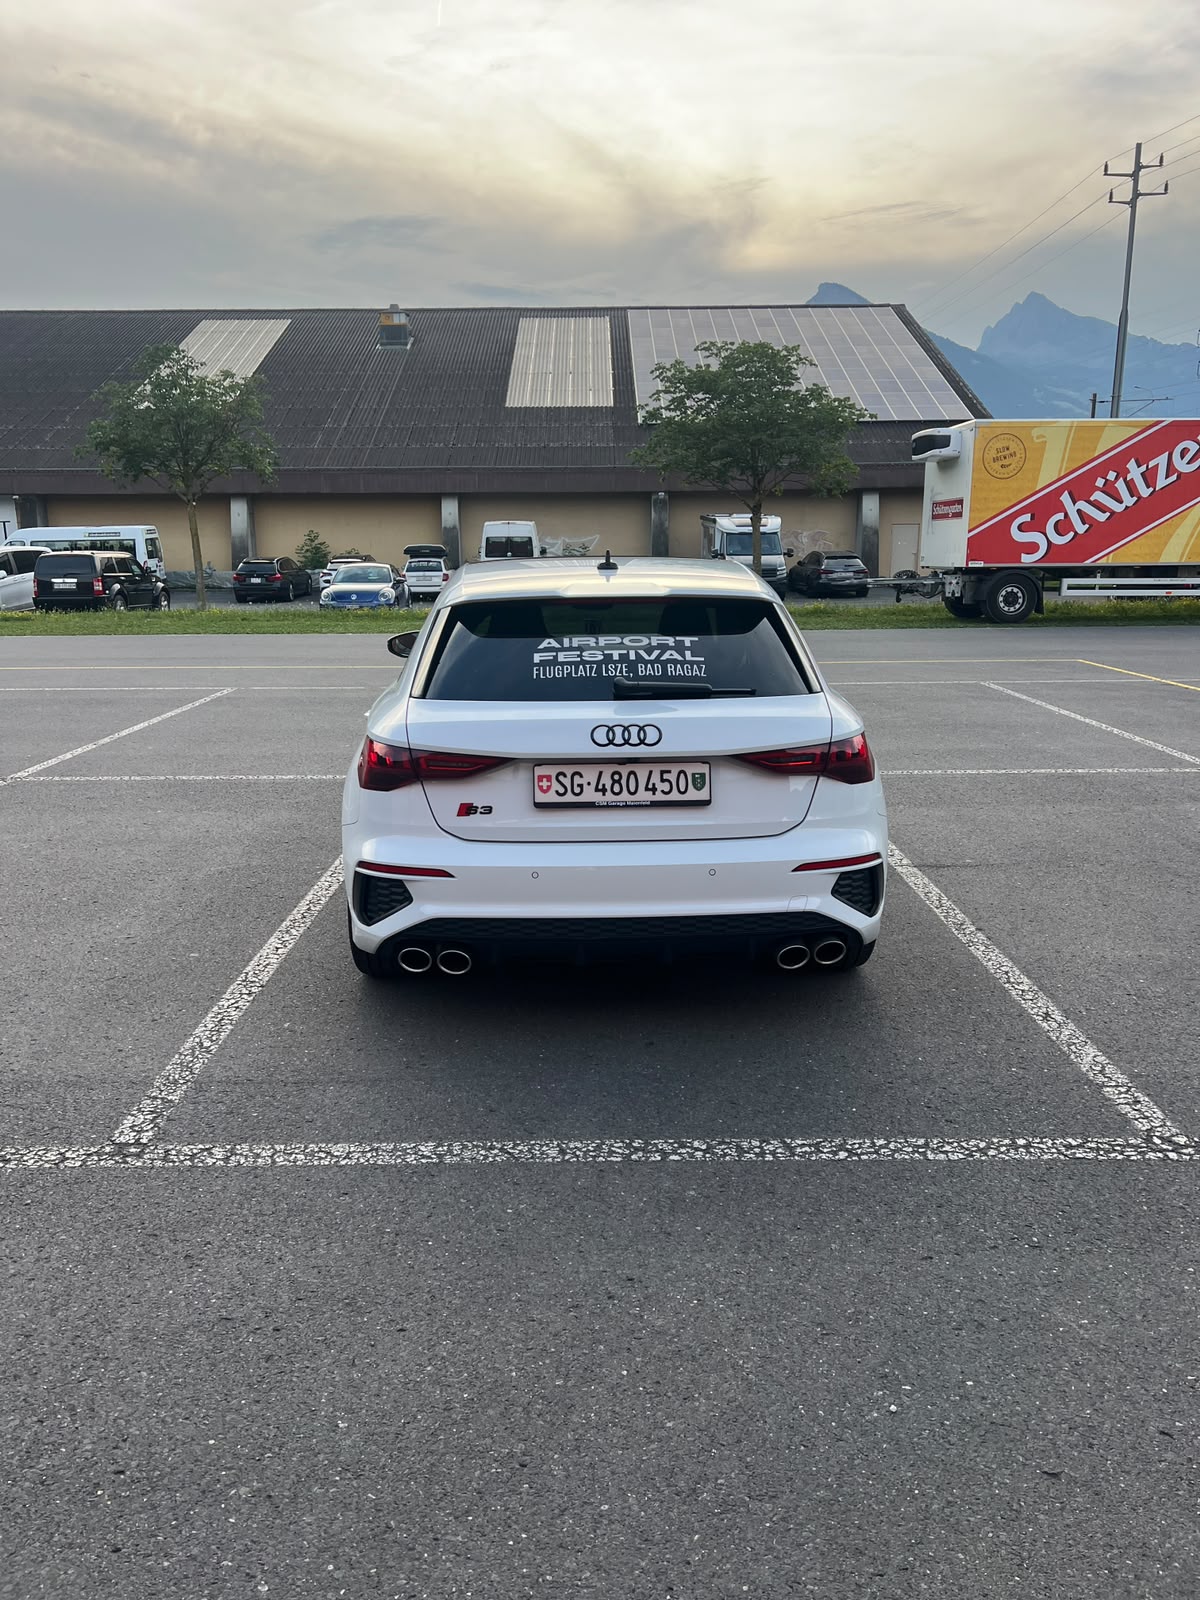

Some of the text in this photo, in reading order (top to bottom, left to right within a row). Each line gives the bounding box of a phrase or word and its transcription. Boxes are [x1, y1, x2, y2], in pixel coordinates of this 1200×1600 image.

[996, 445, 1010, 454] SLOW
[992, 451, 1017, 463] BREWING
[1010, 435, 1200, 562] Schütze
[537, 636, 699, 649] AIRPORT
[533, 650, 705, 663] FESTIVAL
[533, 663, 707, 679] FLUGPLATZ LSZE, BAD RAGAZ
